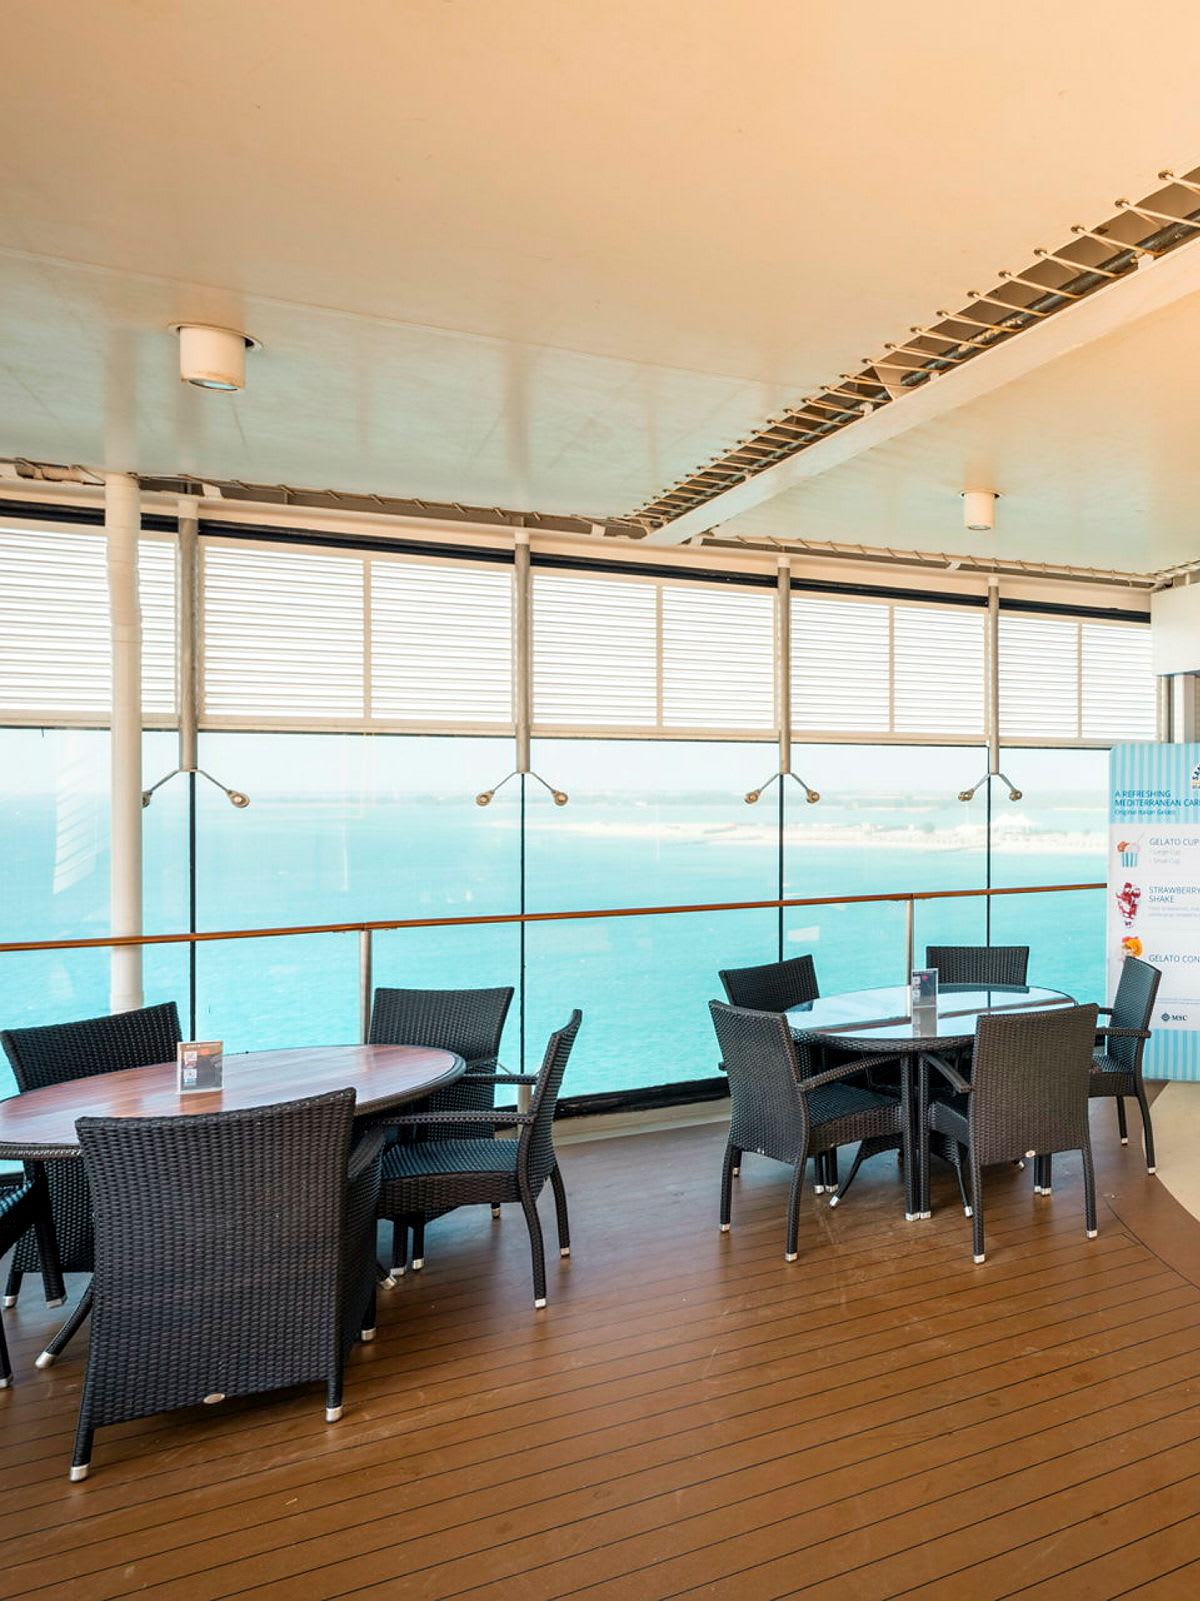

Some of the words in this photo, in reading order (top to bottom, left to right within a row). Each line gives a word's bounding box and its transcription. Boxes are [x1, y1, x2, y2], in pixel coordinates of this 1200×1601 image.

[1123, 790, 1171, 798] REFRESHING
[1115, 799, 1181, 807] MEDITERRANEAN
[1149, 838, 1181, 846] GELATO
[1182, 838, 1200, 846] CUP
[1149, 886, 1200, 894] STRAWBERRY
[1149, 895, 1174, 903] SHAKE
[1149, 954, 1180, 963] GELATO
